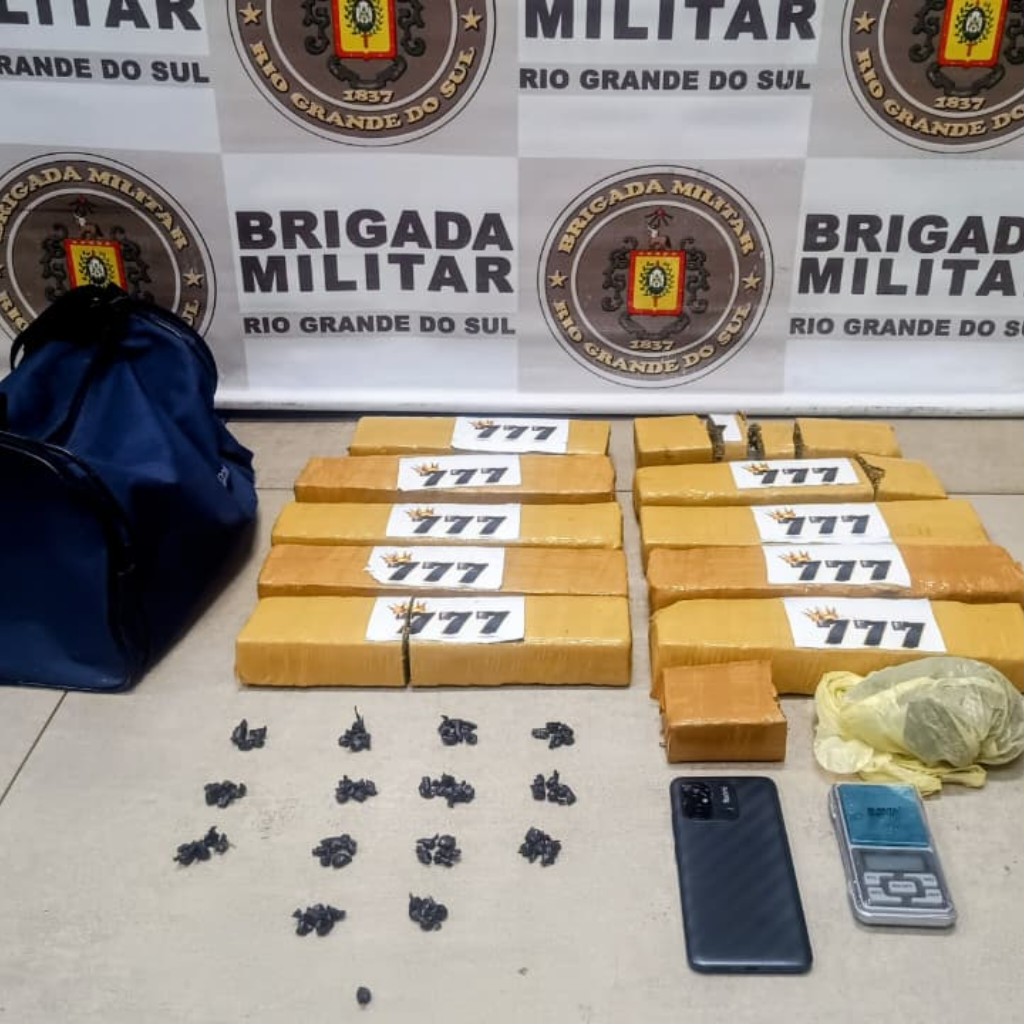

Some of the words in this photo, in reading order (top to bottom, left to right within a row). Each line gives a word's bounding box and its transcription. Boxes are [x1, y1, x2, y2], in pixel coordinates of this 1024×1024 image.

[526, 0, 816, 40] MILITAR
[101, 59, 141, 80] DO
[152, 61, 210, 83] SUL
[520, 68, 569, 89] RIO
[580, 70, 699, 90] GRANDE
[709, 70, 747, 90] DO
[757, 70, 810, 90] SUL
[557, 178, 666, 256] BRIGADA
[671, 180, 756, 257] MILITAR
[235, 209, 513, 250] BRIGADA
[240, 254, 514, 293] MILITAR
[243, 316, 290, 334] RIO
[300, 316, 410, 333] GRANDE
[420, 316, 455, 333] DO
[465, 318, 515, 334] SUL
[790, 318, 834, 334] RIO
[844, 318, 951, 336] GRANDE
[959, 320, 995, 336] DO
[552, 301, 582, 342] RIO
[584, 340, 679, 375] GRANDE
[682, 343, 715, 366] DO
[717, 303, 751, 346] SUL
[629, 339, 674, 352] 1837
[477, 424, 557, 440] 777
[420, 467, 508, 486] 777
[754, 466, 839, 484] 777
[412, 515, 507, 535] 777
[779, 514, 870, 535] 777
[388, 562, 488, 584] 777
[790, 560, 892, 581] 777
[396, 610, 510, 635] 777
[817, 619, 925, 649] 777
